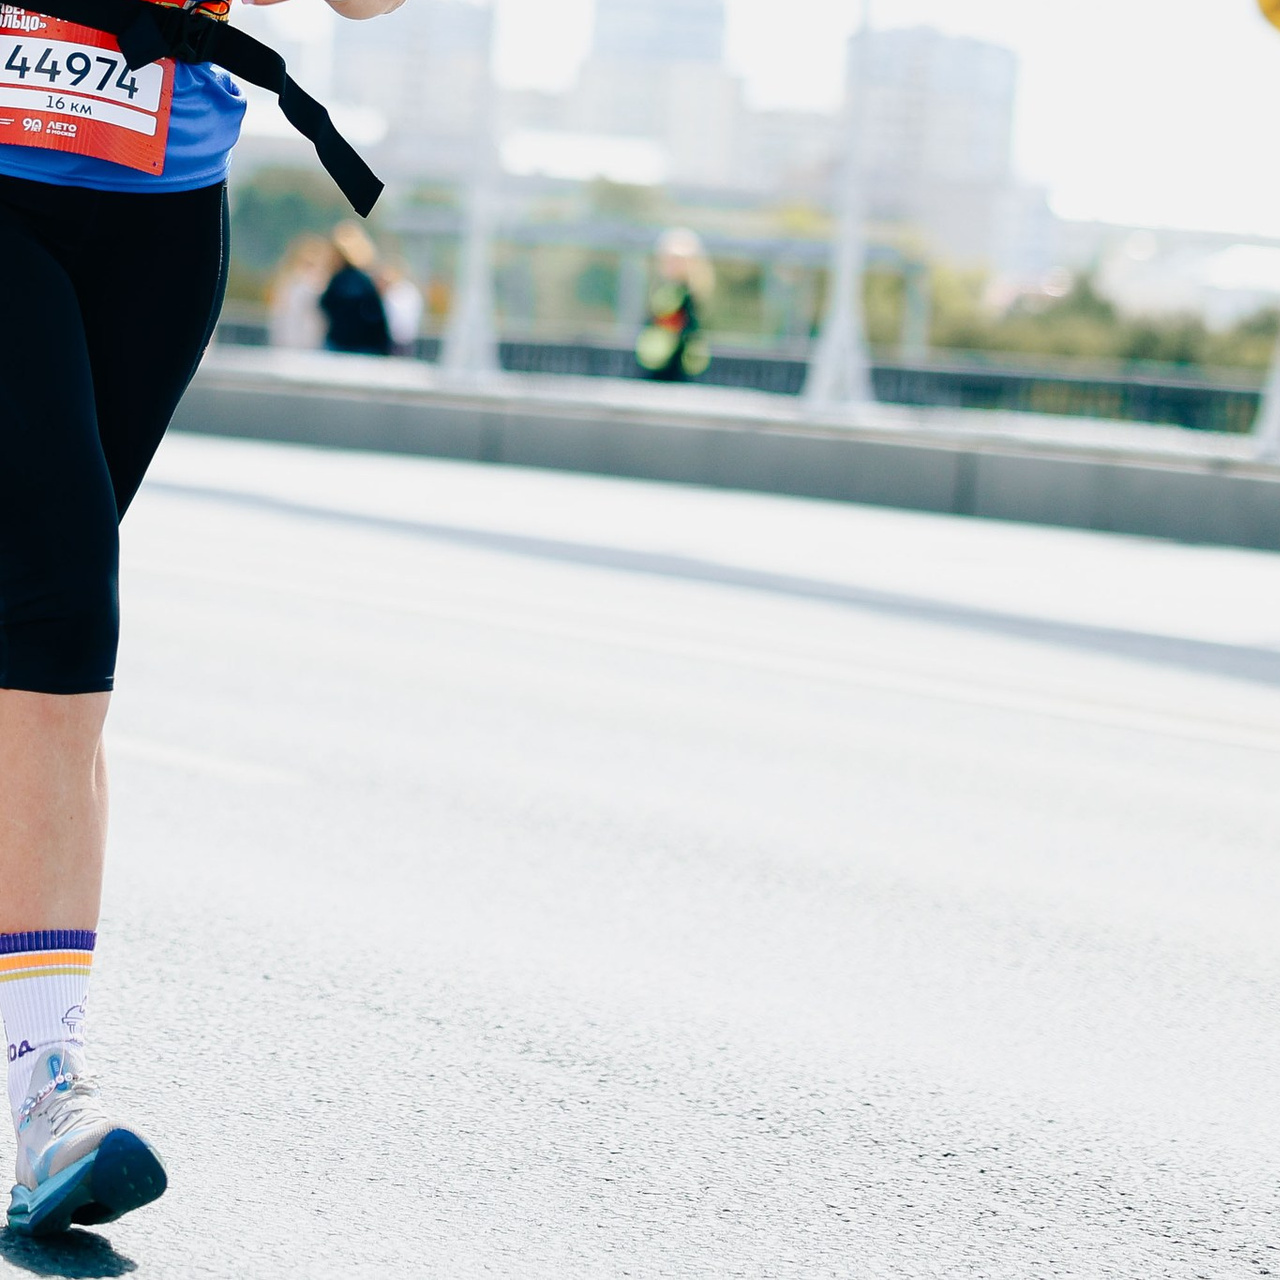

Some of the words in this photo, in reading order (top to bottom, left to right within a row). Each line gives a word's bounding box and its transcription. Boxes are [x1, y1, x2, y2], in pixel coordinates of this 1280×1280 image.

[5, 45, 139, 100] 44974
[46, 95, 65, 110] 16
[46, 121, 77, 132] ЛЕТО
